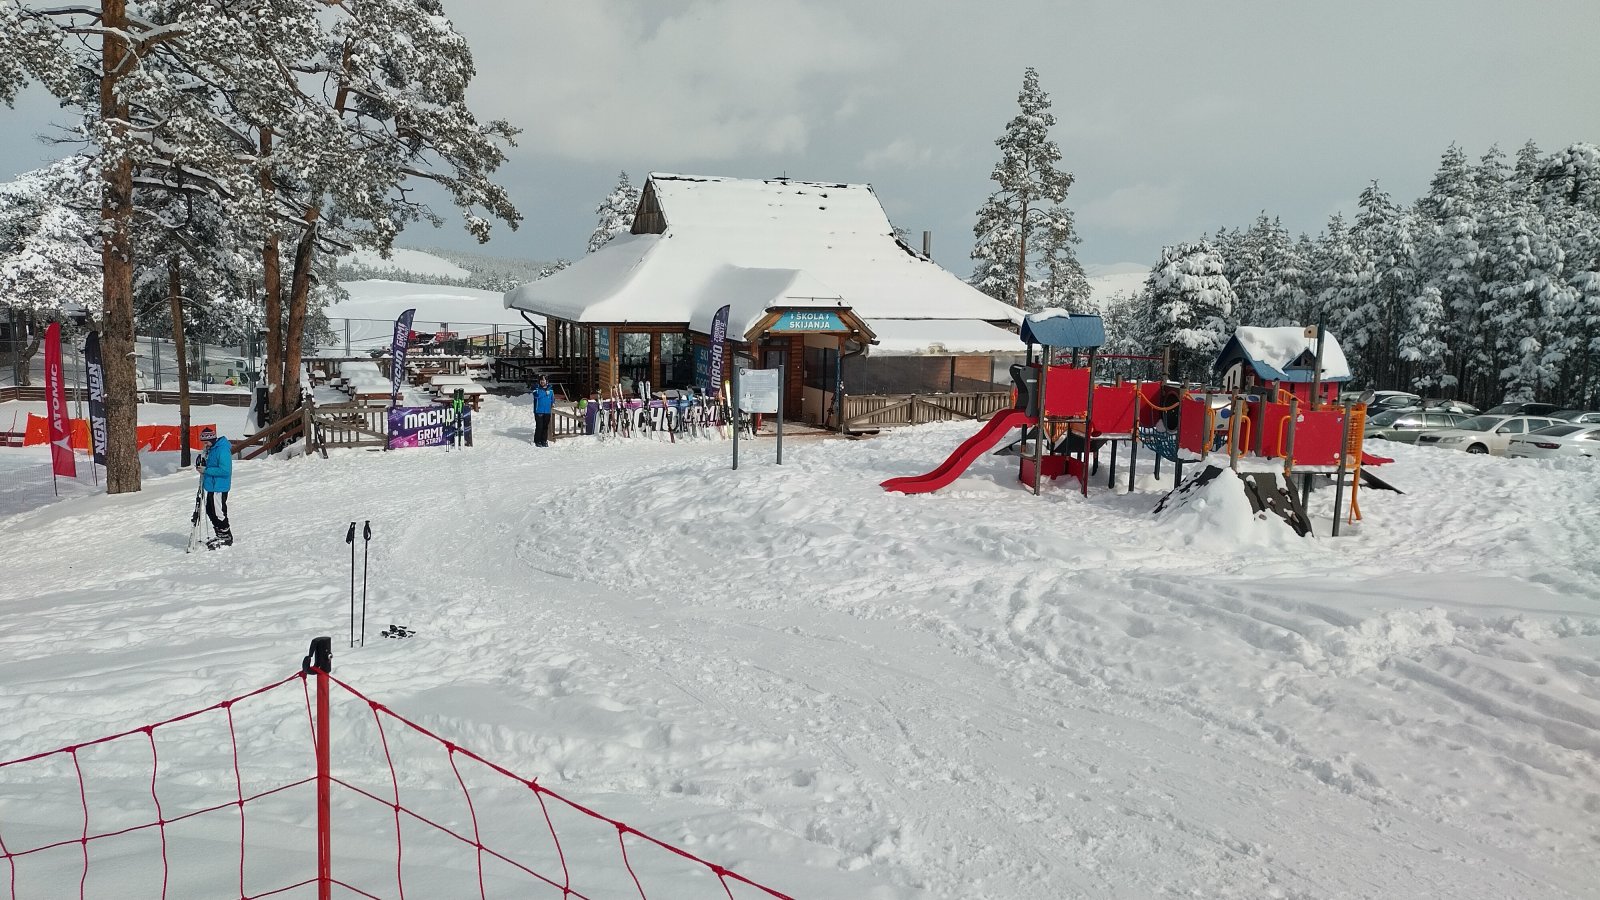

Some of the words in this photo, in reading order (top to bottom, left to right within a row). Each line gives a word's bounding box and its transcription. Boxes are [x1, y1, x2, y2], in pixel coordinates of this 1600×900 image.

[789, 321, 830, 329] SKIJANJA
[796, 311, 824, 320] ŠKOLA
[87, 361, 103, 402] NGN
[710, 344, 723, 389] MACHO
[51, 363, 64, 433] ATOMIC
[92, 415, 106, 456] NGN
[404, 408, 455, 430] MACHO
